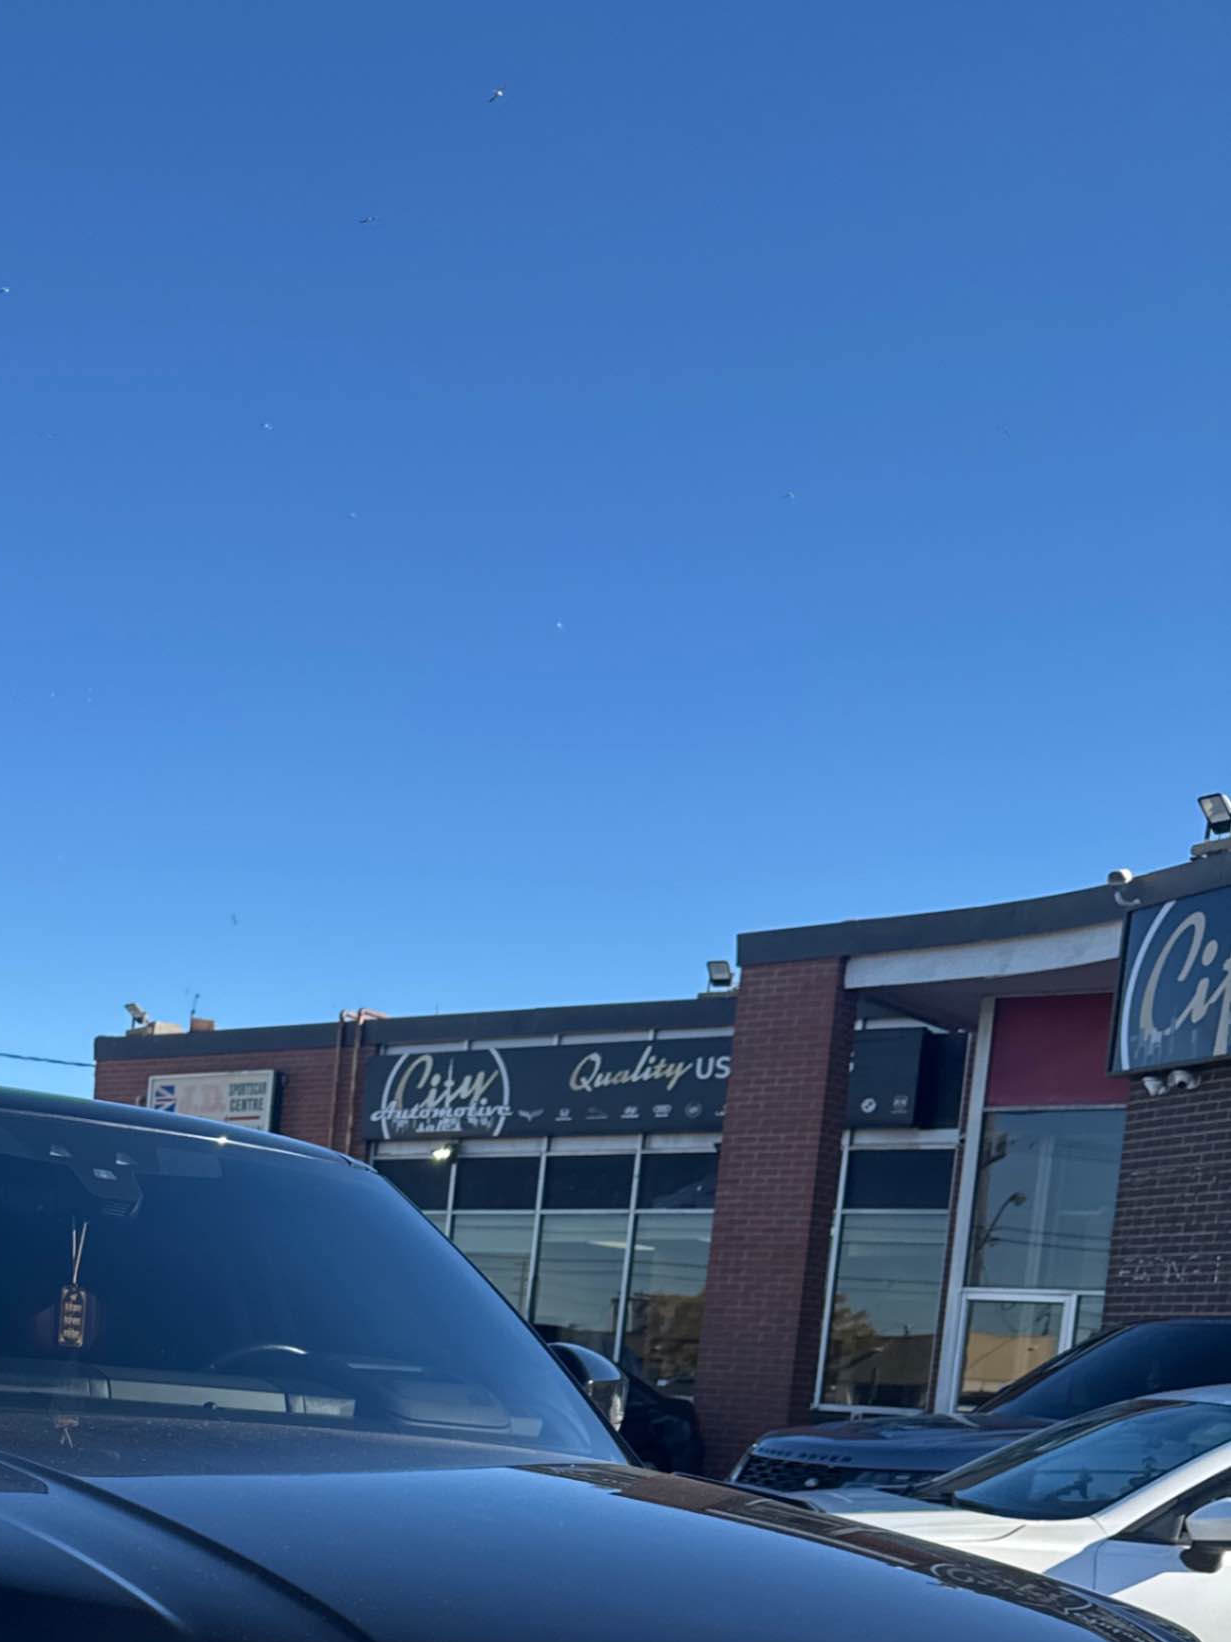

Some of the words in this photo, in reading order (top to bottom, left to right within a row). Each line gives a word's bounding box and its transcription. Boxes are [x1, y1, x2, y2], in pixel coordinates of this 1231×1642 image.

[394, 1054, 499, 1110] City
[570, 1045, 691, 1092] Quality
[229, 1098, 264, 1112] CENTRE
[370, 1097, 513, 1122] Automotive
